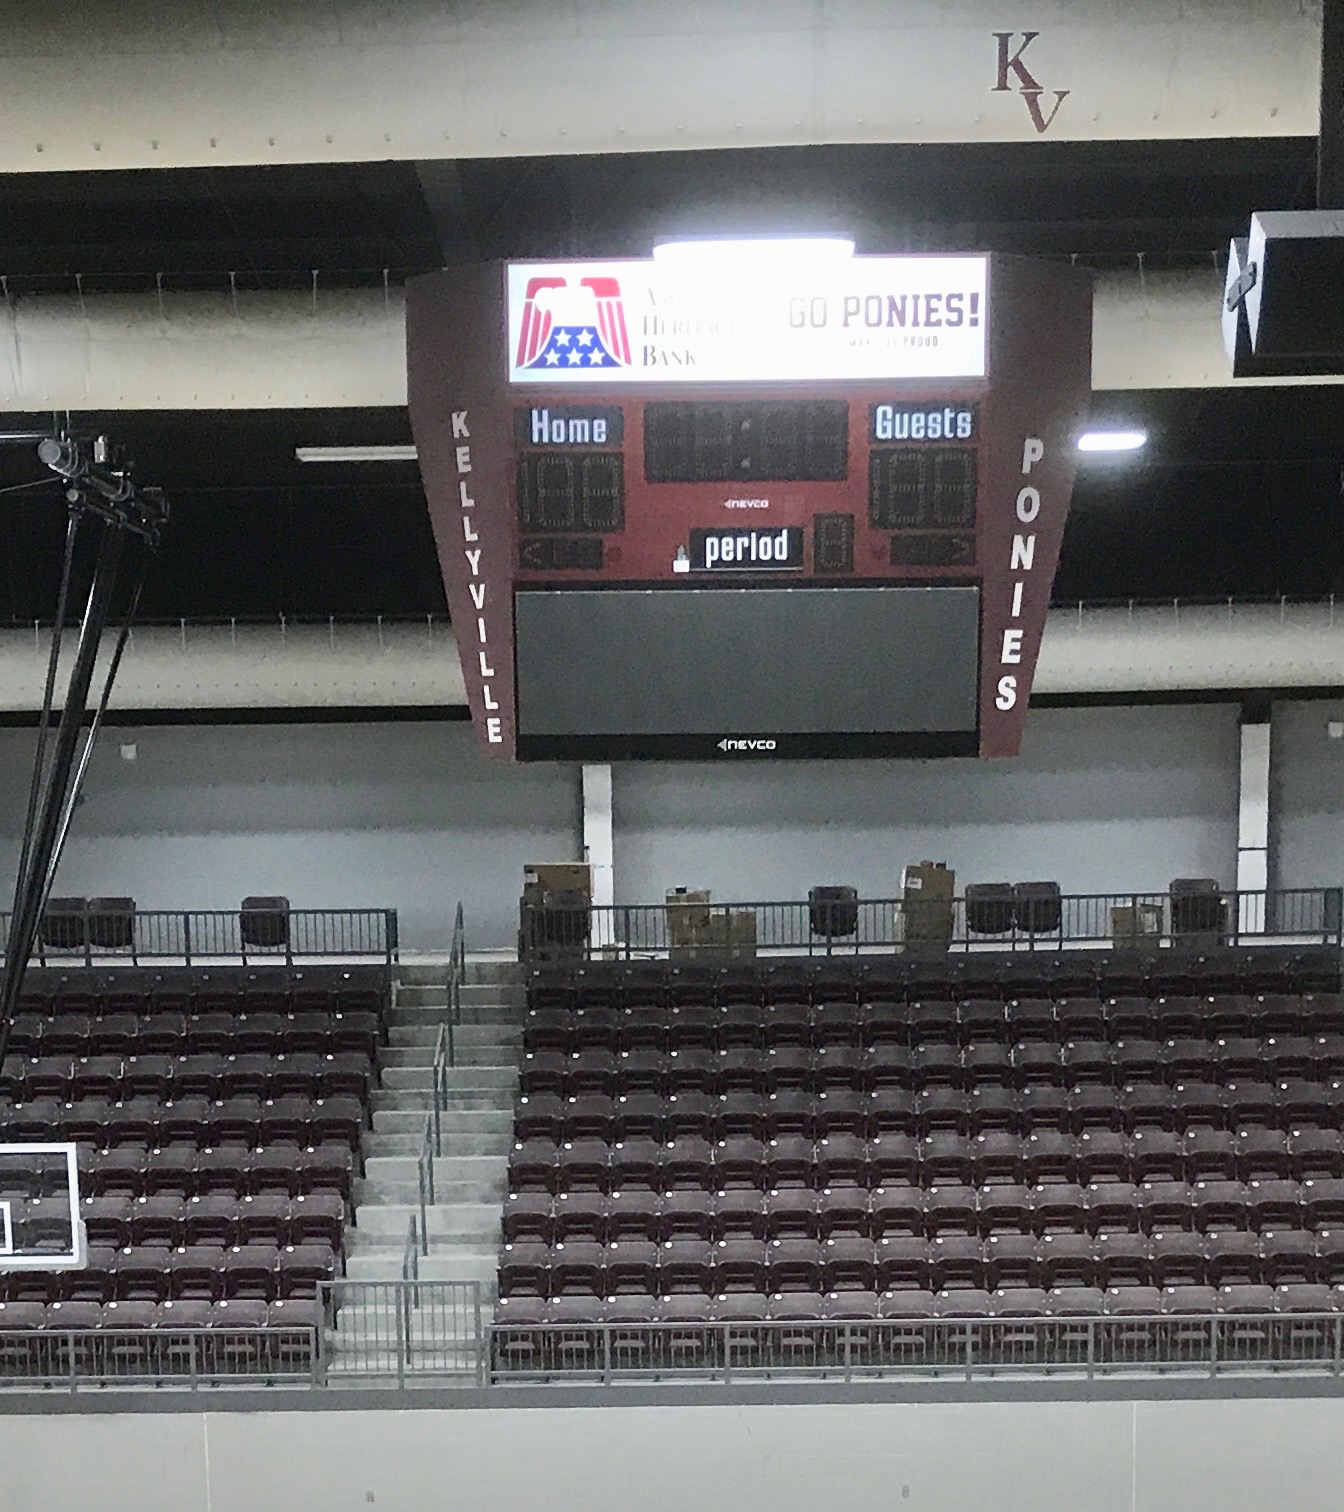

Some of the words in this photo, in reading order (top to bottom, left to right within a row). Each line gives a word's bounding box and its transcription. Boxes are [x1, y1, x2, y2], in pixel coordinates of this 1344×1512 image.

[789, 297, 827, 328] GO
[842, 292, 979, 328] PONIES!
[531, 407, 607, 444] Home
[875, 405, 973, 440] Guests
[705, 528, 789, 568] period
[451, 411, 502, 743] KELLYVILLE
[995, 438, 1044, 711] PONIES
